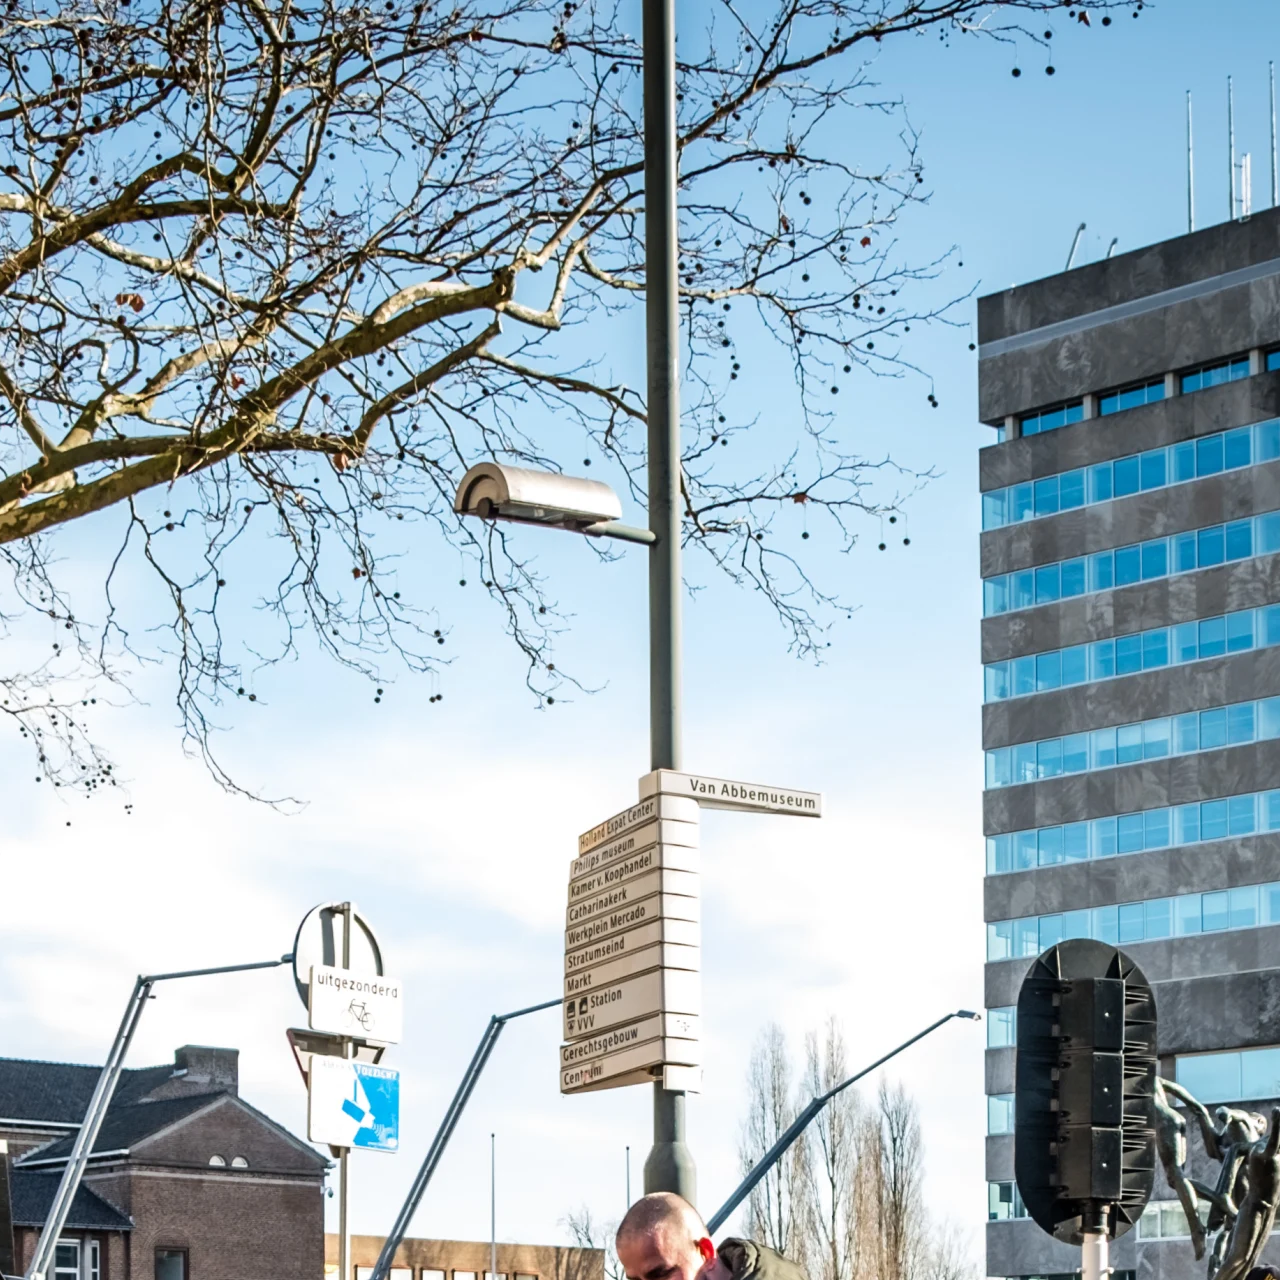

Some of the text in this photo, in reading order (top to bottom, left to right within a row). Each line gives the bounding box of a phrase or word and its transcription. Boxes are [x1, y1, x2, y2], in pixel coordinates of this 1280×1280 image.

[690, 778, 816, 809] Van Abbemuseum
[580, 801, 654, 849] Holland Expat Center
[574, 837, 635, 875] Philips museum
[571, 851, 652, 898] Kamer v. Koophandel
[569, 887, 628, 922] Catharinakerk
[568, 905, 646, 945] Werkplein Mercado
[568, 936, 625, 969] Stratumseind
[317, 972, 398, 999] uitgezonderd
[567, 972, 592, 992] Markt
[590, 988, 622, 1009] Station
[577, 1014, 595, 1032] VVV
[563, 1027, 639, 1062] Gerechtsgebouw
